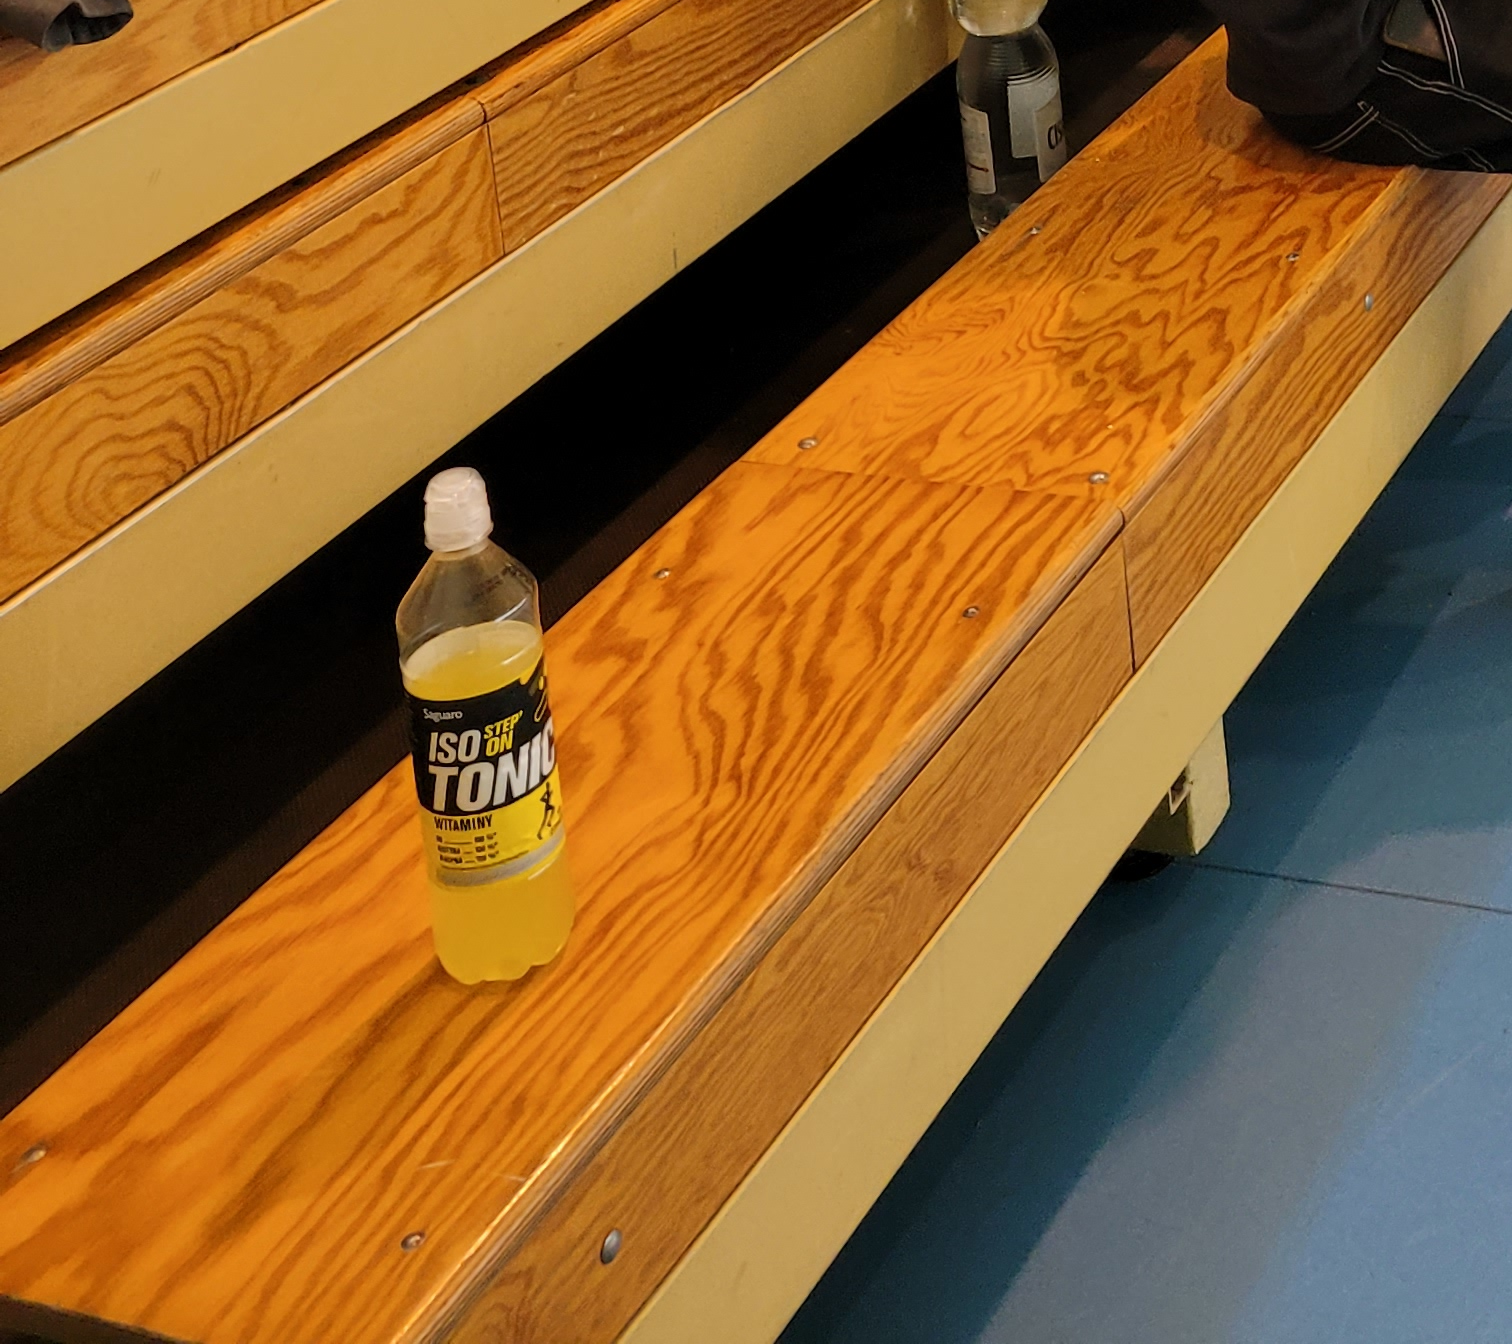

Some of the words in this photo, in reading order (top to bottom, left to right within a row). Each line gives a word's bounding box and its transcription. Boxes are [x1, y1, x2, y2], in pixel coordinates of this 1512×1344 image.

[422, 708, 463, 722] Saguaro
[428, 728, 482, 764] ISO
[485, 729, 514, 757] ON
[428, 716, 556, 813] TONIC
[434, 814, 493, 831] WITAMINY
